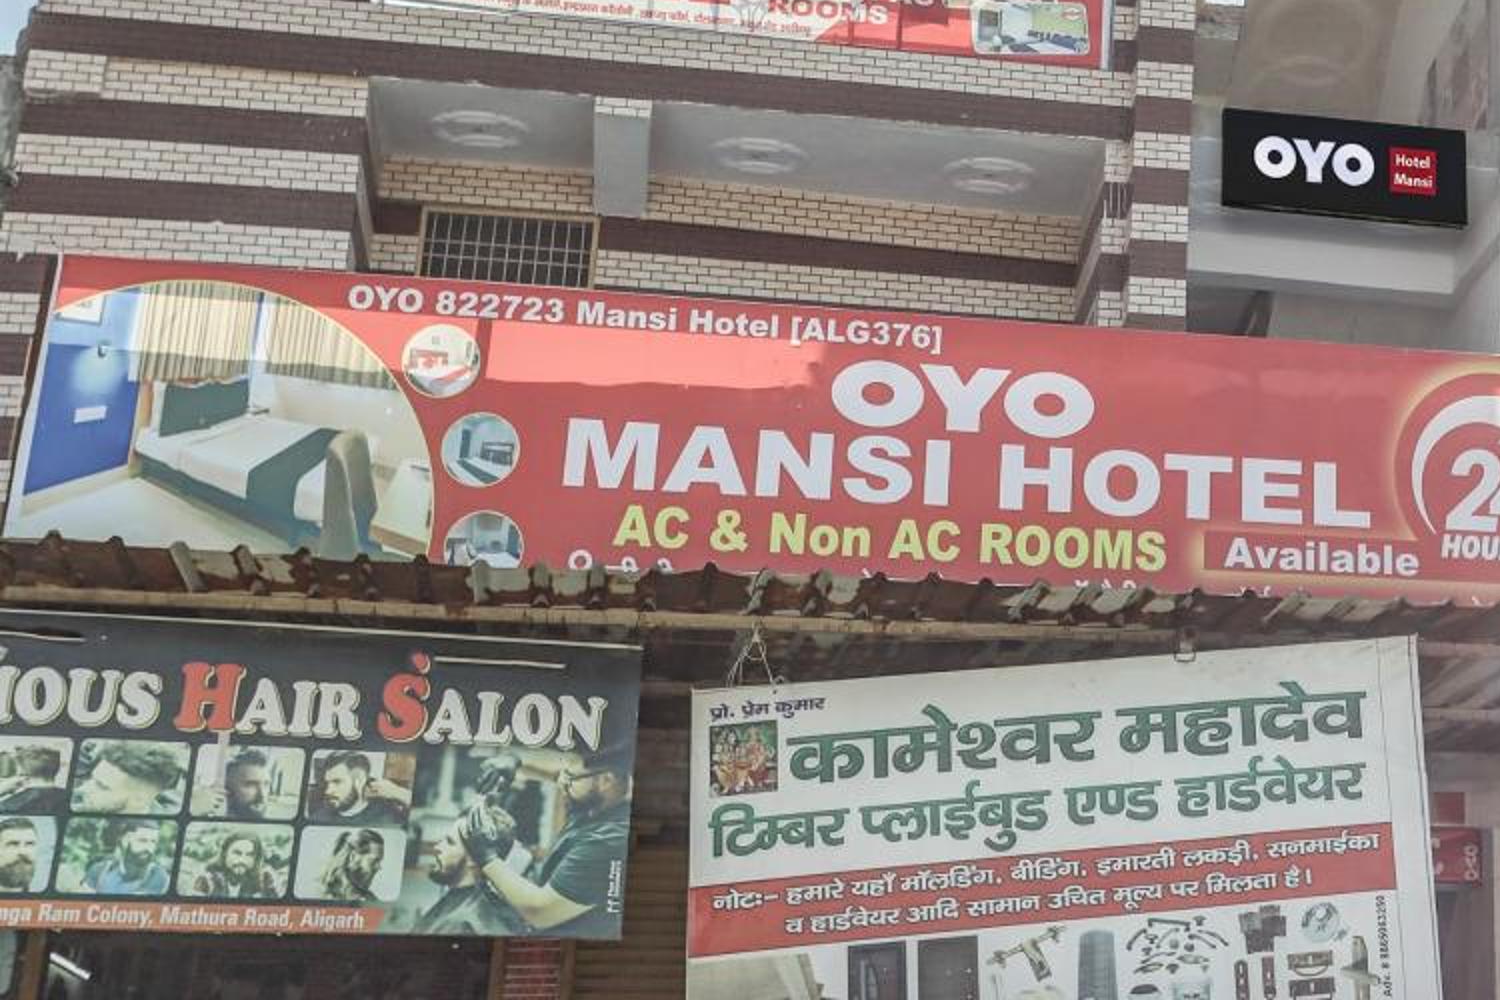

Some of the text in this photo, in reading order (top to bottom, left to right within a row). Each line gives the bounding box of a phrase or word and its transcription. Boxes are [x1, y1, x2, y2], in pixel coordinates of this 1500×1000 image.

[1253, 135, 1375, 187] OYO
[1394, 173, 1433, 188] Mansi
[1395, 154, 1431, 169] Hotel
[349, 284, 943, 356] OYO 822723 Mansi Hotel [ALG376]
[831, 359, 1095, 438] OYO
[562, 417, 1372, 530] MANSI HOTEL
[613, 504, 1168, 573] AC & Non AC ROOMS
[1223, 536, 1420, 578] Available
[173, 661, 361, 742] HAIR
[377, 654, 609, 751] SALON
[774, 697, 827, 719] कुमार
[786, 680, 1367, 783] कामेश्वर महादेव
[708, 755, 1367, 858] टिम्बर प्लाईबुड एण्ड हार्डवेयर
[785, 877, 846, 906] हमारे
[851, 870, 897, 897] यहाँ
[1096, 846, 1176, 877] इमारती
[810, 905, 901, 933] हार्डवेयर
[906, 897, 961, 923] आदि
[966, 894, 1041, 917] सामान
[1047, 884, 1106, 909] उचित
[1112, 883, 1163, 911] मूल्य
[1170, 879, 1200, 898] पर
[1205, 869, 1279, 895] मिलता
[37, 904, 80, 923] Ram
[86, 904, 153, 928] Colony,
[160, 906, 240, 926] Mathura
[244, 908, 293, 930] Road,
[300, 908, 365, 933] Aligarh
